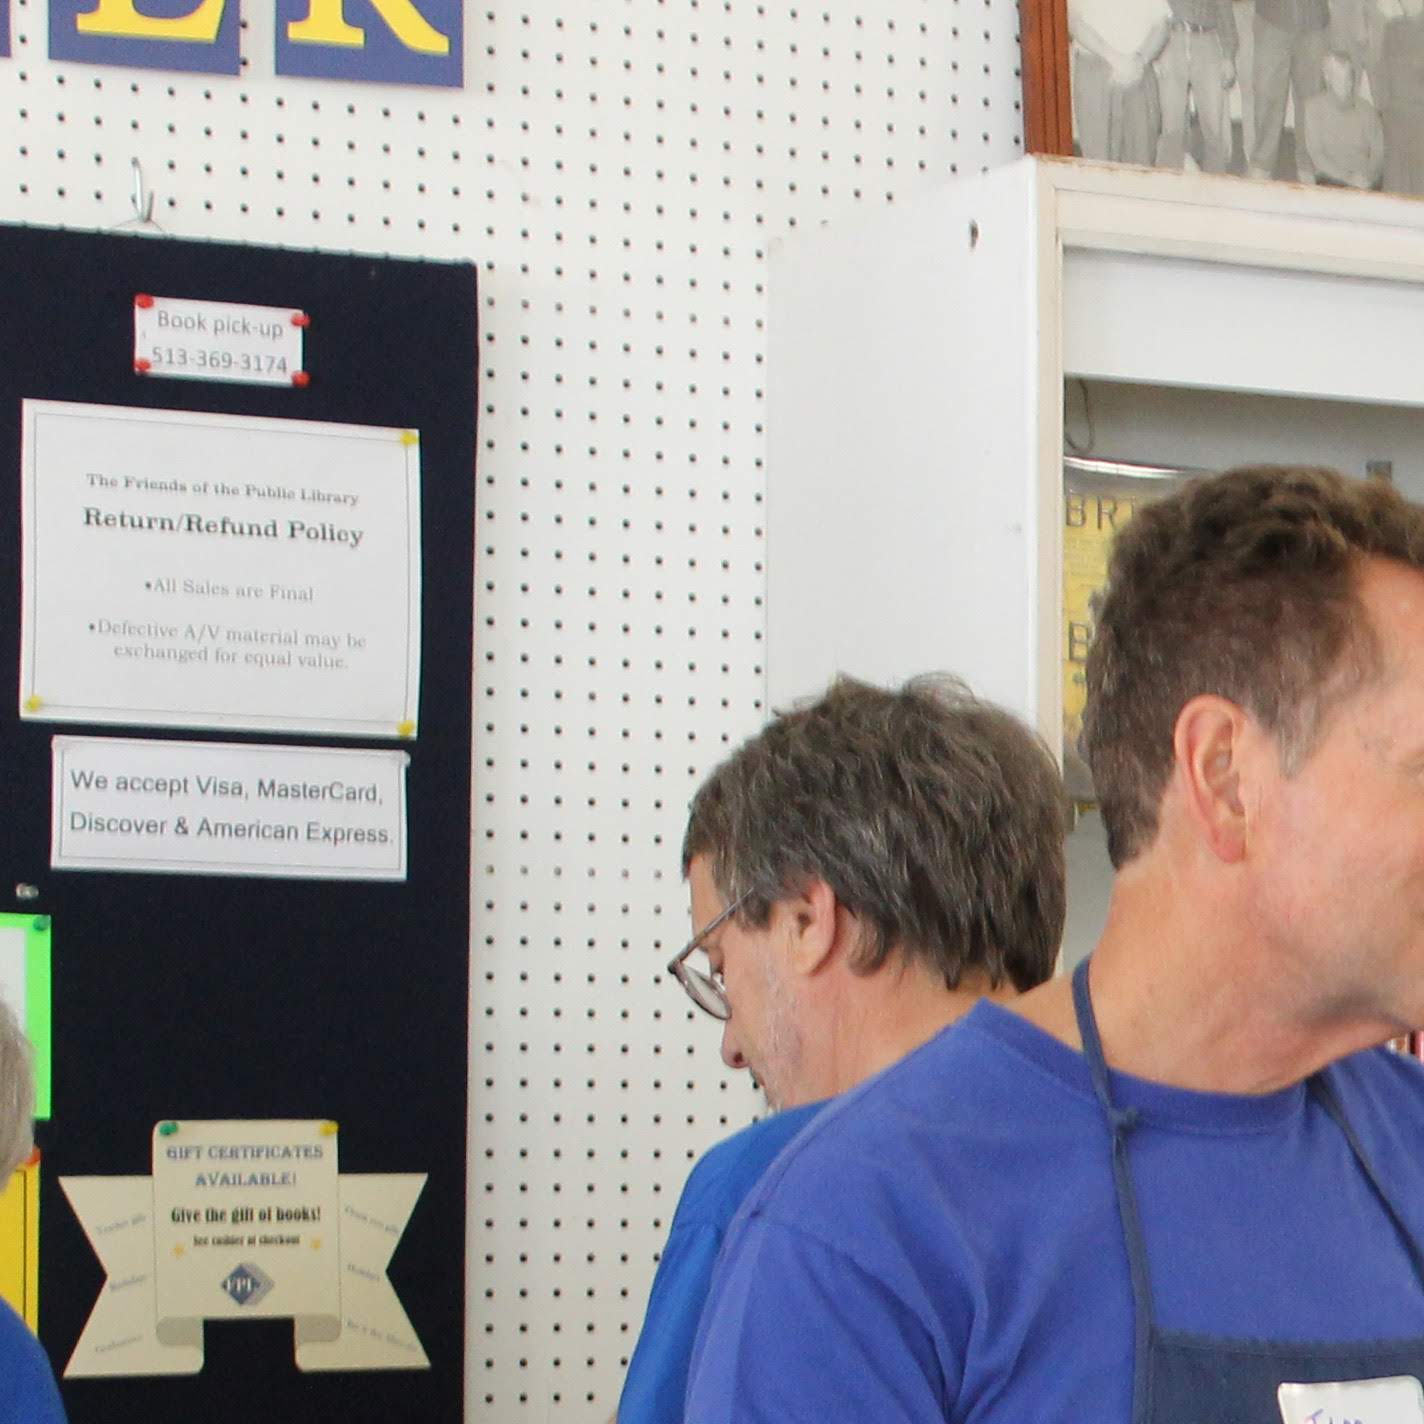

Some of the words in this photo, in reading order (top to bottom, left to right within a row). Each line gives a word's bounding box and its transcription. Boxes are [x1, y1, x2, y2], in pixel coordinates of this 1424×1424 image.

[157, 310, 207, 331] Book
[213, 313, 284, 340] pick-up
[152, 346, 287, 373] 513-369-3174
[86, 472, 118, 488] The
[123, 476, 187, 493] Friends
[192, 481, 208, 494] of
[214, 482, 240, 496] the
[245, 484, 296, 500] Public
[300, 488, 359, 507] Library
[83, 506, 279, 539] Return/Refund
[288, 520, 364, 548] Policy
[153, 578, 176, 594] All
[183, 580, 230, 597] Sales
[235, 586, 264, 599] are
[269, 584, 314, 603] Final
[98, 618, 178, 639] Defective
[184, 624, 221, 643] A/V
[226, 628, 298, 647] material
[304, 634, 341, 651] may
[347, 633, 367, 649] be
[114, 643, 209, 665] exchanged
[214, 647, 237, 664] for
[244, 650, 291, 670] equal
[297, 654, 349, 671] value.
[71, 769, 108, 790] We
[115, 775, 188, 798] accept
[195, 775, 249, 800] Visa,
[257, 779, 384, 806] MasterCard,
[70, 811, 167, 835] Discover
[174, 817, 189, 835] &
[197, 817, 299, 842] American
[306, 822, 394, 848] Express.
[167, 1145, 202, 1160] GIFT
[208, 1145, 323, 1159] CERTIFICATES
[195, 1172, 297, 1187] AVAILABLE!
[171, 1207, 200, 1223] Give
[205, 1207, 226, 1222] the
[232, 1206, 254, 1225] gift
[259, 1207, 272, 1221] of
[276, 1206, 321, 1222] books!
